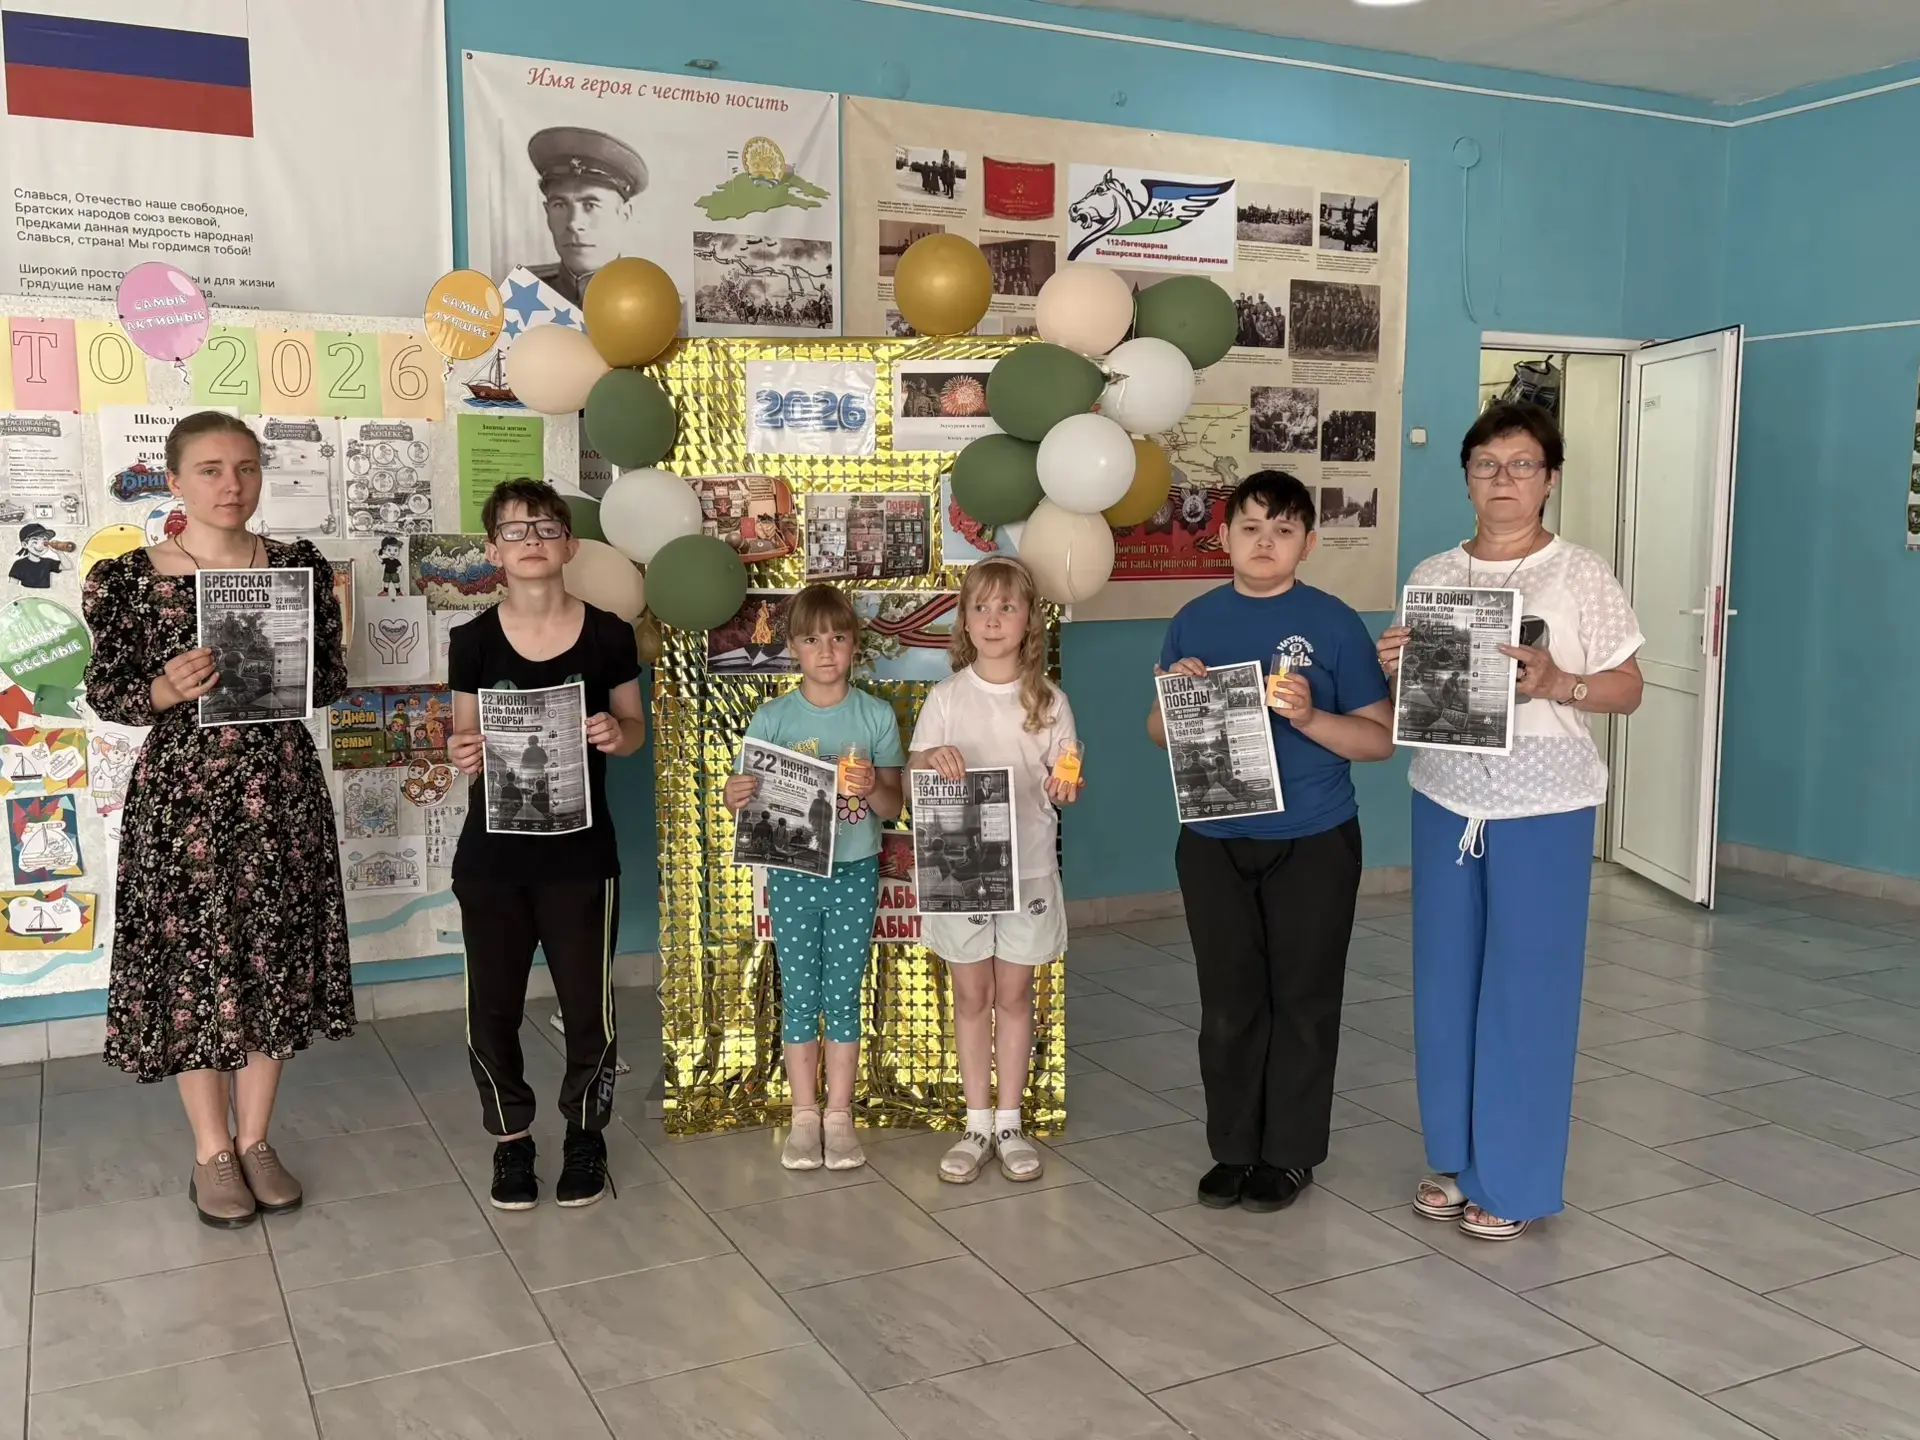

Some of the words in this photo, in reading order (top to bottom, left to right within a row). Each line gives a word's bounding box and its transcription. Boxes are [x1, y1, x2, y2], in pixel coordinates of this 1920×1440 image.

[527, 67, 575, 89] Имя
[581, 76, 632, 99] героя
[638, 84, 647, 97] с
[652, 84, 720, 106] честью
[726, 92, 789, 113] носить
[14, 188, 71, 203] Славься,
[75, 192, 142, 207] Отечество
[145, 200, 177, 210] наше
[180, 202, 248, 217] свободное,
[15, 202, 74, 215] Братских
[78, 208, 130, 220] народов
[134, 213, 165, 223] союз
[168, 215, 220, 228] вековой,
[16, 216, 81, 230] Предками
[84, 223, 129, 234] данная
[132, 227, 191, 238] мудрость
[194, 231, 254, 243] народная!
[16, 231, 74, 245] Славься,
[78, 236, 125, 247] страна!
[128, 238, 149, 249] Мы
[152, 242, 210, 253] гордимся
[214, 246, 251, 256] тобой!
[19, 263, 78, 277] Широкий
[81, 269, 127, 279] просто
[203, 276, 211, 284] и
[214, 277, 235, 287] для
[240, 278, 275, 288] жизни
[20, 278, 84, 292] Грядущие
[88, 283, 112, 292] нам
[134, 294, 187, 310] САМЫЕ
[442, 293, 491, 320] САМЫЕ
[126, 310, 205, 331] АКТИВНЫЕ
[432, 311, 489, 339] ЛУЧШИЕ
[208, 336, 430, 400] 2026
[755, 389, 868, 431] 2026
[138, 452, 168, 460] пло
[204, 575, 272, 588] БРЕСТСКАЯ
[204, 589, 270, 602] КРЕПОСТЬ
[1406, 592, 1433, 604] ДЕТИ
[1436, 591, 1473, 606] ВОЙНЫ
[1405, 605, 1436, 613] МАЛЕНЬКИЕ
[1475, 608, 1483, 616] 22
[1485, 609, 1504, 617] ИЮНЯ
[9, 625, 68, 654] САМЫЕ
[11, 639, 83, 676] ВЕСЁЛЫЕ
[1162, 677, 1194, 694] ЦЕНА
[482, 695, 493, 705] 22
[497, 696, 527, 706] ИЮНЯ
[1165, 690, 1210, 708] ПОБЕДЫ
[482, 706, 503, 715] ДЕНЬ
[505, 707, 539, 716] ПАМЯТИ
[483, 715, 489, 724] И
[491, 716, 524, 725] СКОРБИ
[1174, 721, 1183, 730] 22
[753, 750, 777, 774] 22
[781, 758, 809, 775] ИЮНЯ
[781, 768, 797, 780] 1941
[799, 774, 819, 787] ГОДА
[918, 774, 930, 786] 22
[919, 786, 939, 797] 1941
[942, 786, 969, 797] ГОДА
